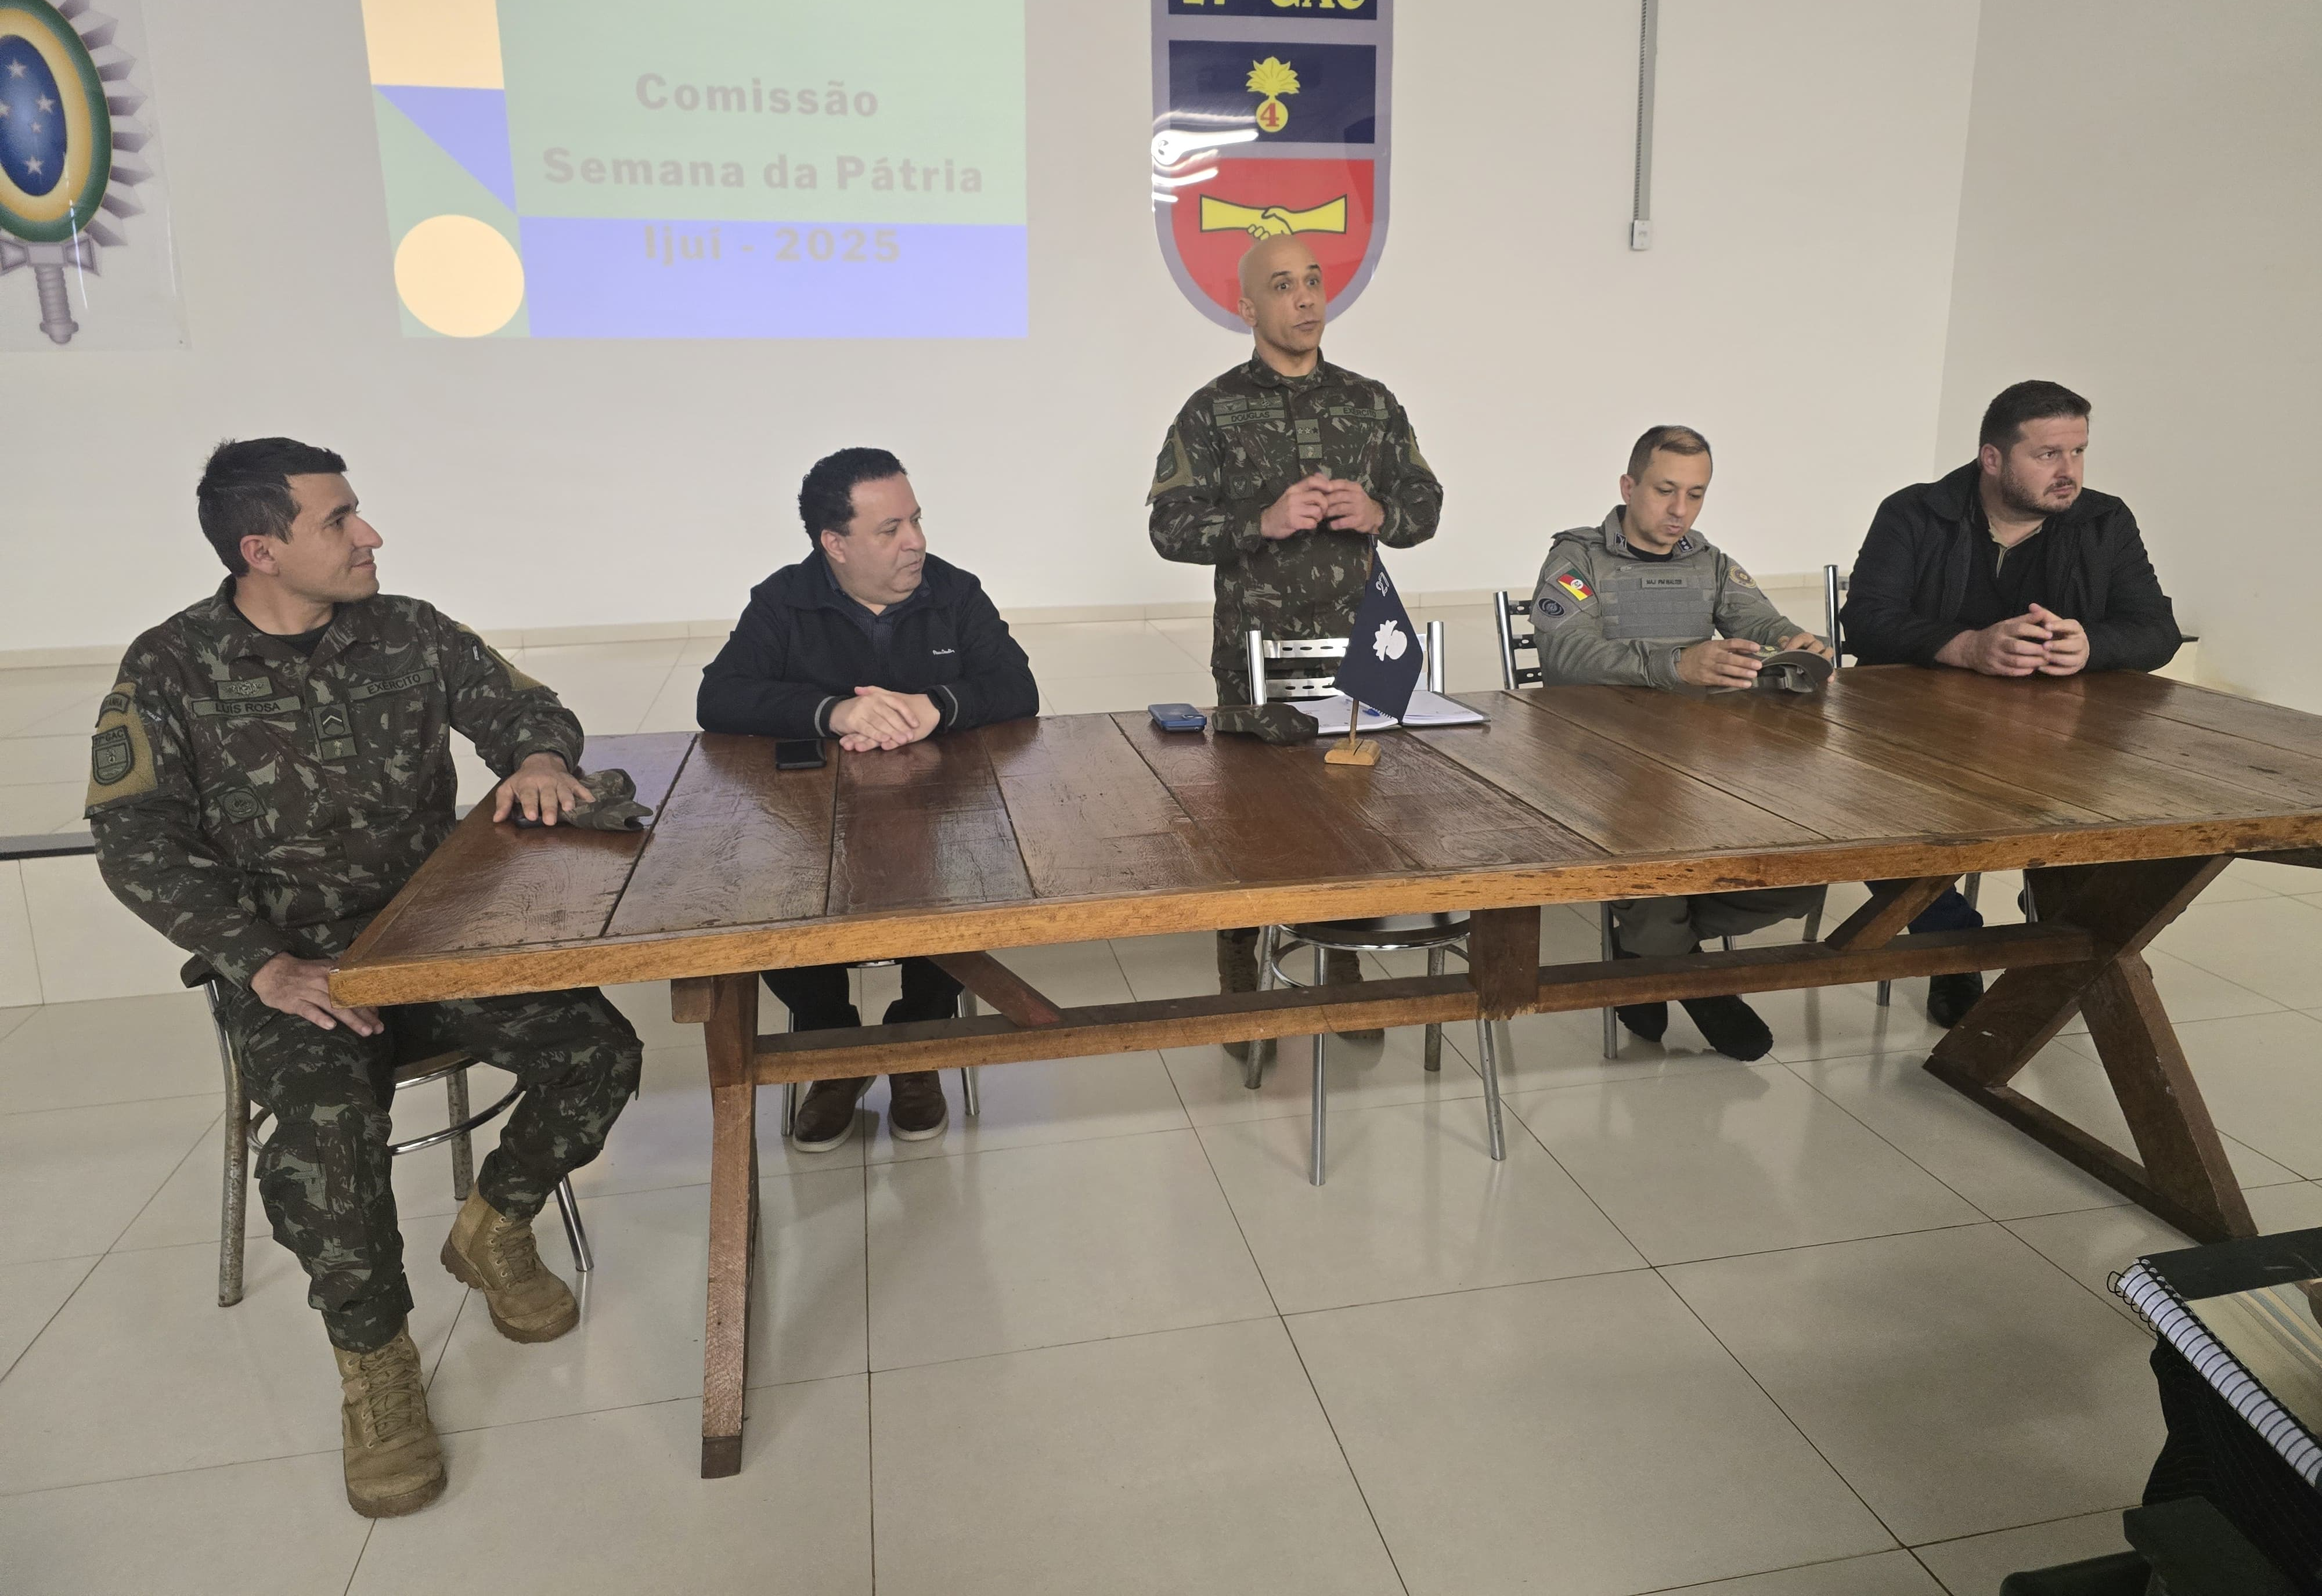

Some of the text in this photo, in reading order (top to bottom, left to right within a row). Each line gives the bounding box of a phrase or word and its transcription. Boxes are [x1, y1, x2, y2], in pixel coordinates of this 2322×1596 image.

[635, 73, 879, 118] Comissão
[1260, 103, 1279, 127] 4
[542, 147, 984, 194] Semana da Pátria
[644, 225, 720, 266] Ijuí
[774, 228, 901, 262] 2025
[1231, 411, 1270, 422] DOUGLAS
[244, 702, 281, 713] ROSA
